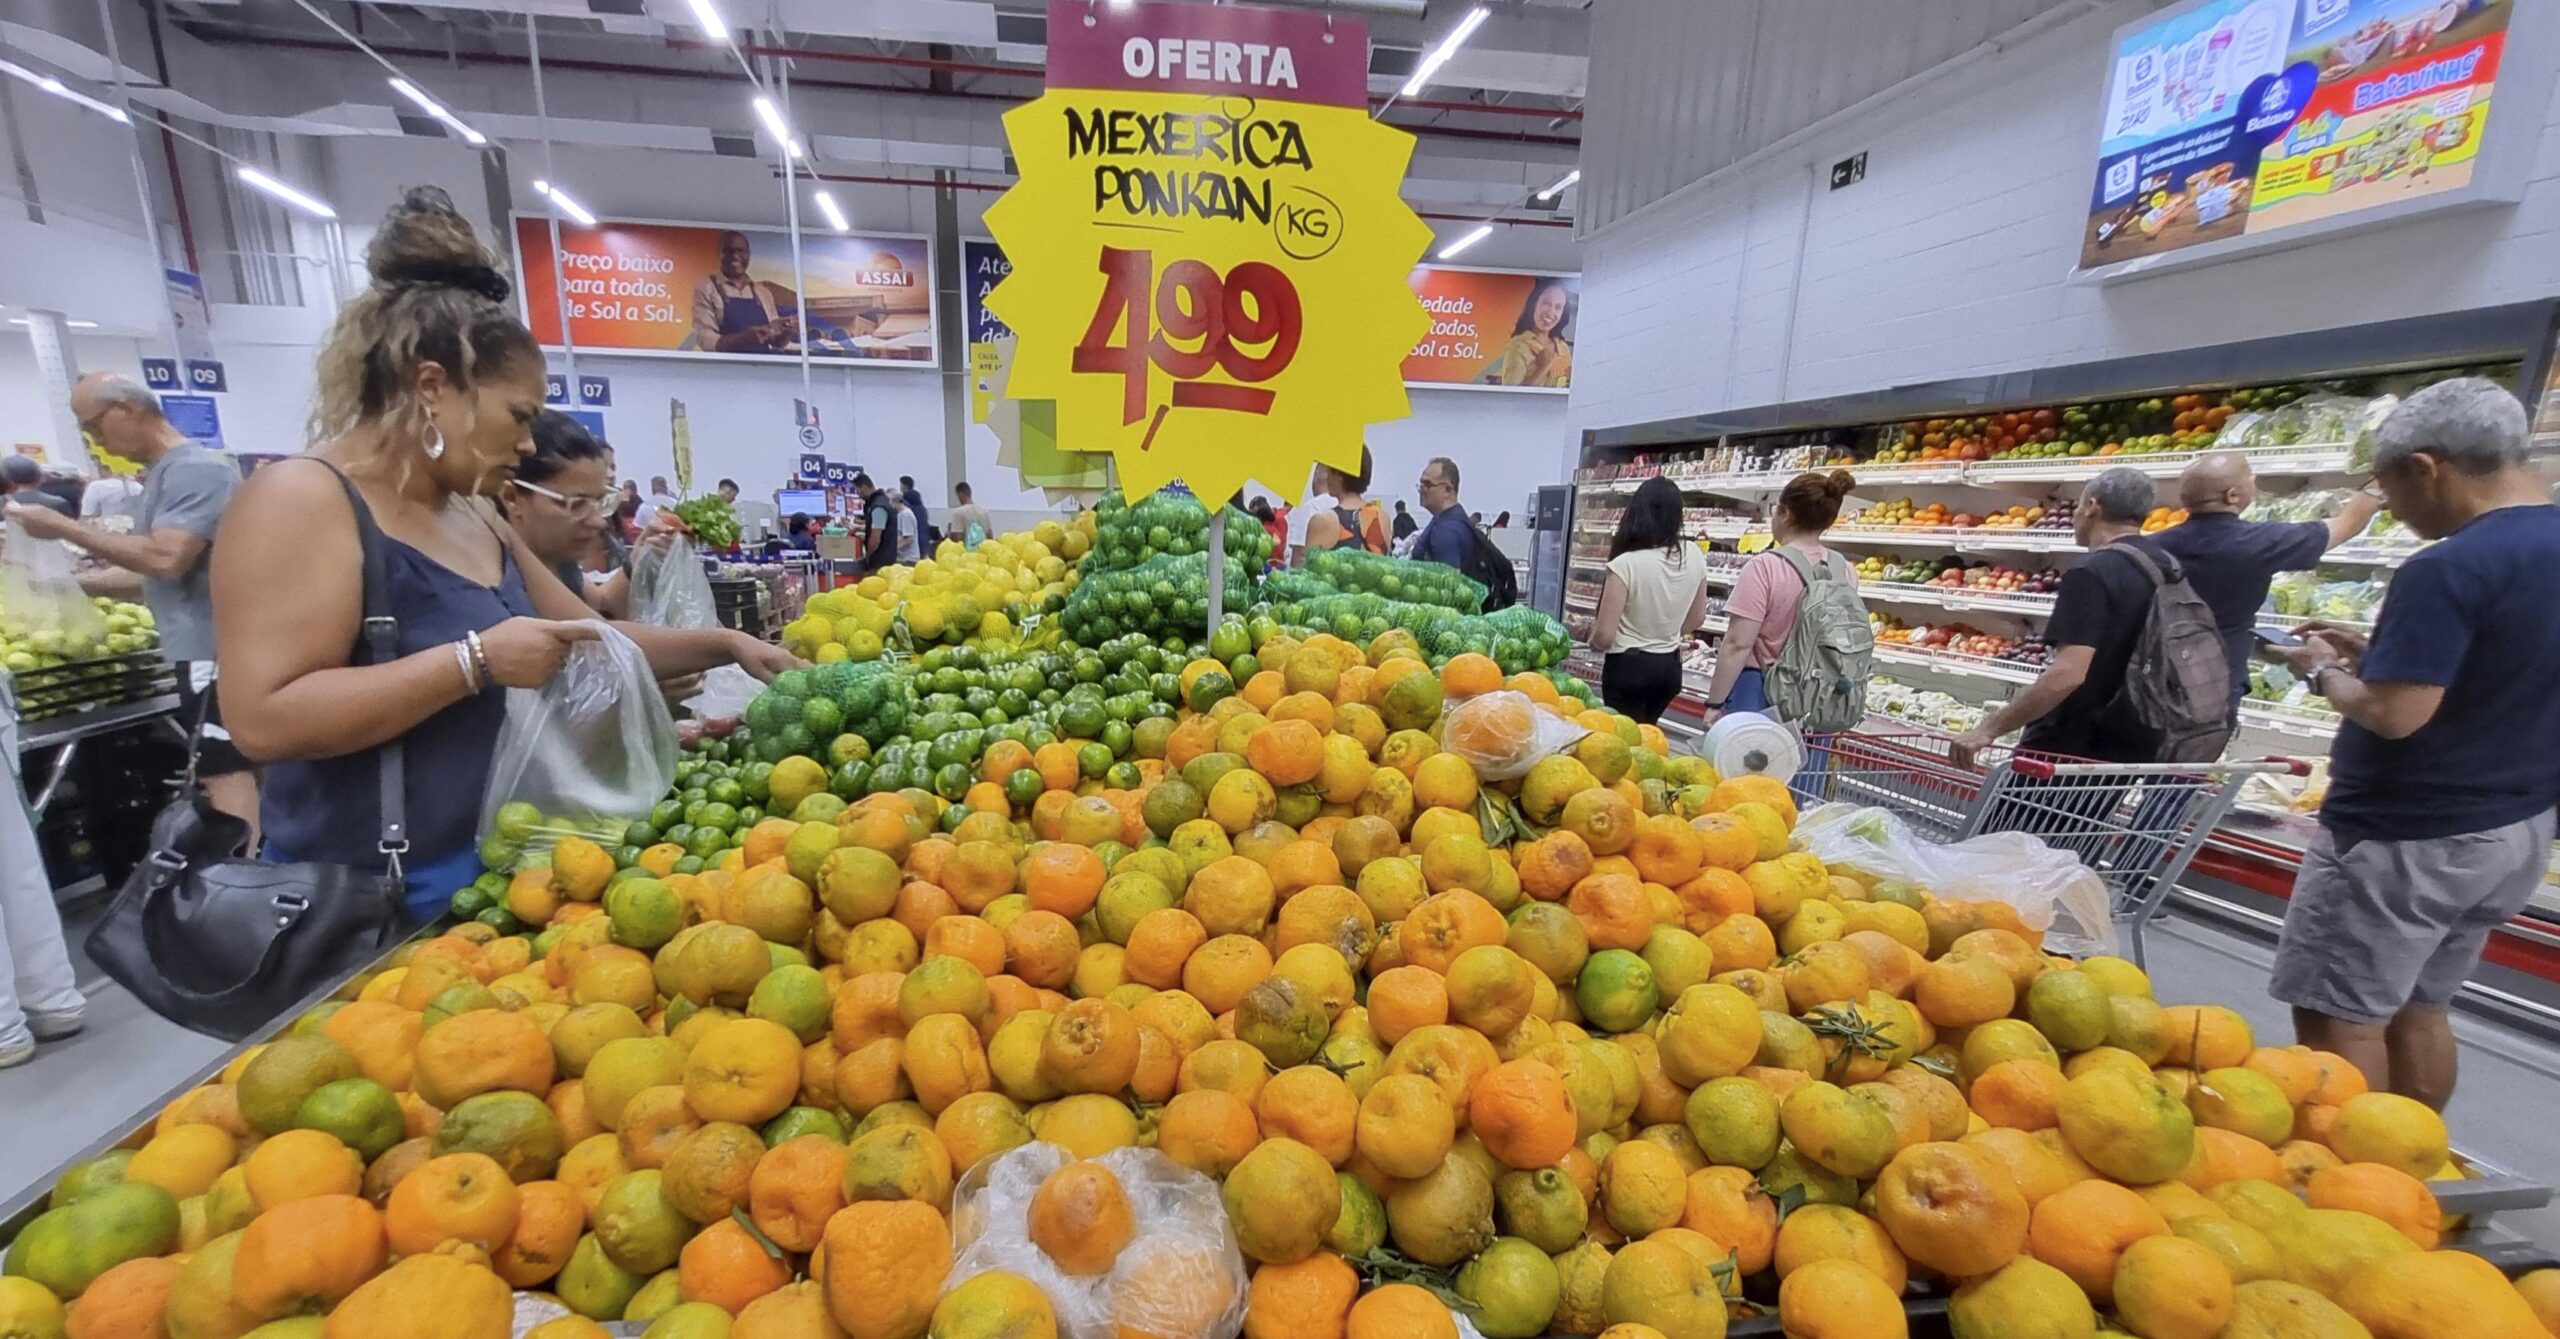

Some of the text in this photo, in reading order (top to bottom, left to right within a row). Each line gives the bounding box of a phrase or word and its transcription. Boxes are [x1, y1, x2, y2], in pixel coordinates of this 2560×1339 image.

[1122, 37, 1298, 88] OFERTA
[2245, 109, 2295, 133] Batavo
[1063, 98, 1313, 171] MEXERICA
[1095, 165, 1329, 238] PONKAN KG
[618, 253, 674, 273] baixo
[610, 278, 671, 300] todos,
[590, 301, 621, 320] Sol
[625, 306, 638, 320] a
[644, 304, 682, 322] Sol.
[1430, 319, 1479, 339] todos,
[1438, 345, 1449, 357] a
[1453, 342, 1483, 359] Sol.
[148, 367, 168, 382] 10
[194, 369, 216, 383] 09
[584, 384, 603, 397] 07
[804, 461, 820, 472] 04
[828, 469, 843, 479] 05
